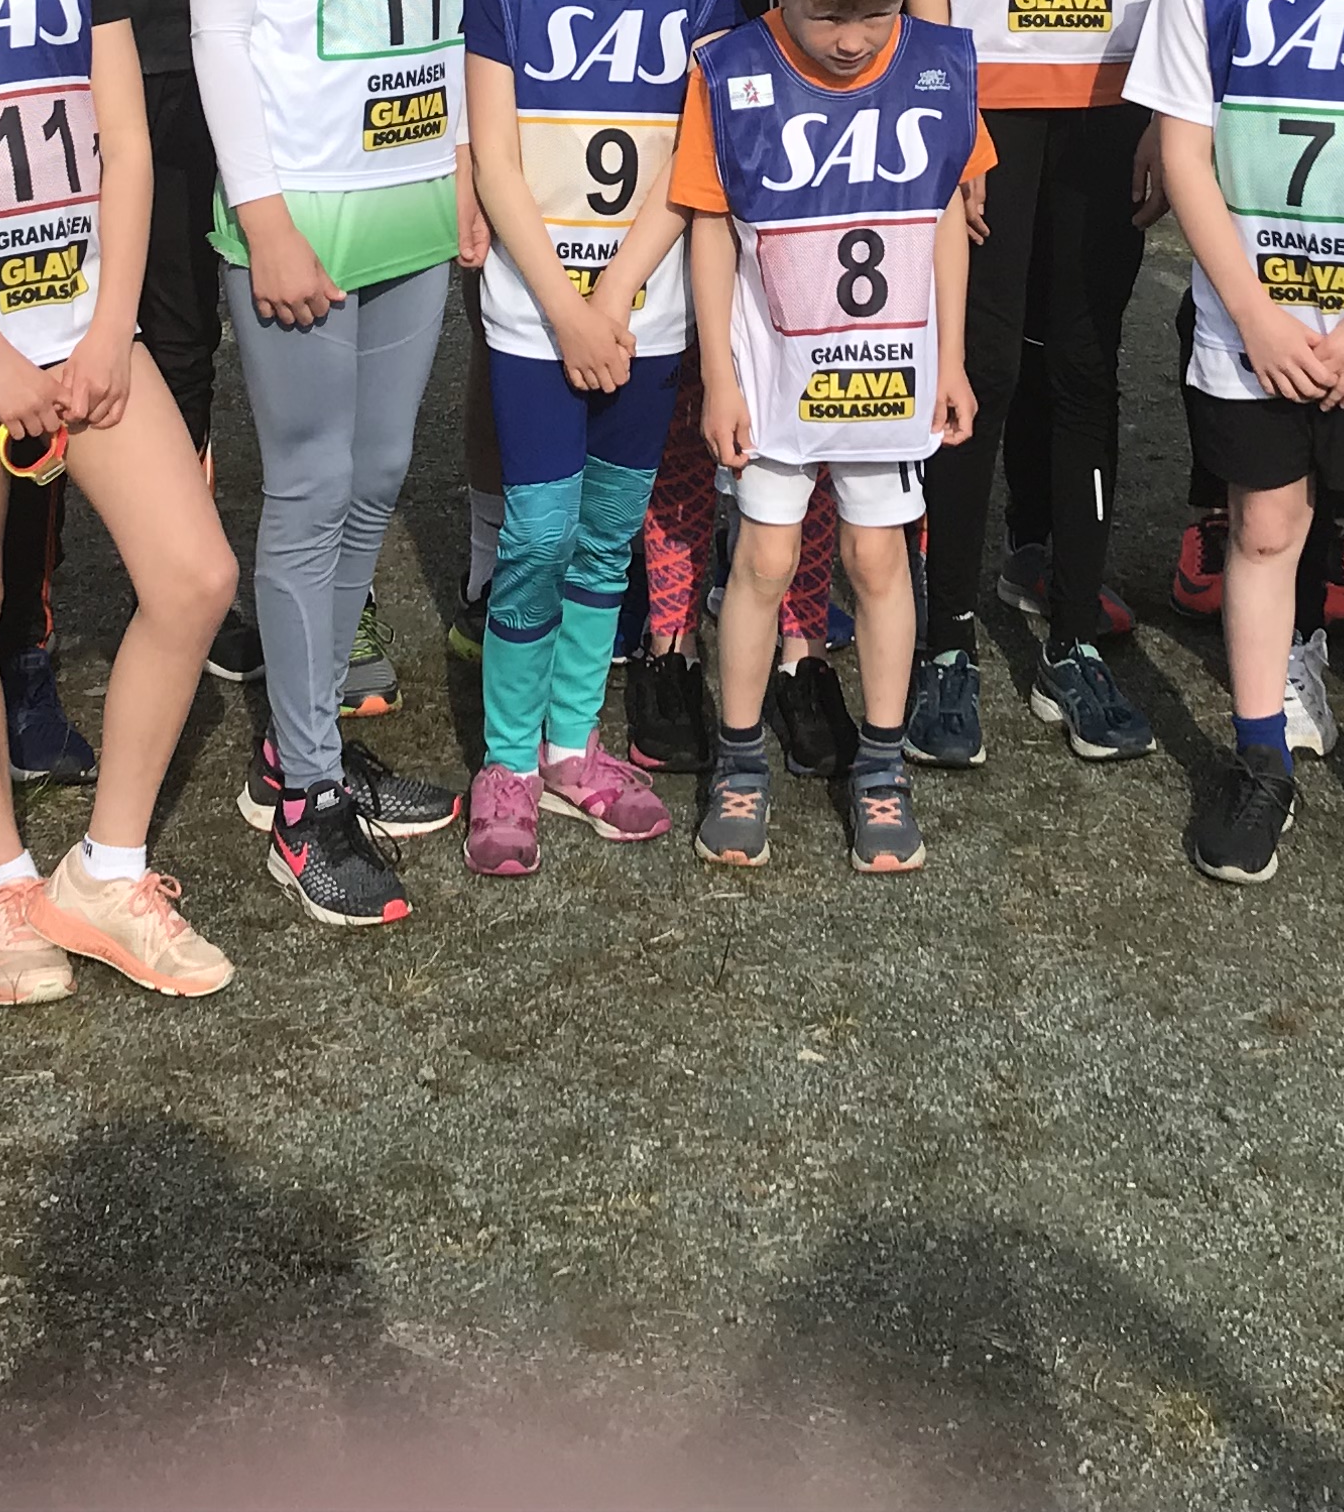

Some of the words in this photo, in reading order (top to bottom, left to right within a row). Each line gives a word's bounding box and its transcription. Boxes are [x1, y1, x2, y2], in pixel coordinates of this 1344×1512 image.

[1017, 14, 1105, 29] ISOLASJON
[524, 5, 687, 85] SAS
[367, 62, 445, 93] GRANÅSEN
[370, 91, 444, 128] GLAVA
[372, 120, 441, 147] ISOLASJON
[761, 106, 944, 192] SAS
[586, 128, 638, 216] 9
[1278, 119, 1335, 208] 7
[1, 245, 78, 287] GLAV
[836, 228, 889, 318] 8
[805, 369, 909, 401] GLAVA
[808, 401, 907, 420] ISOLASJON
